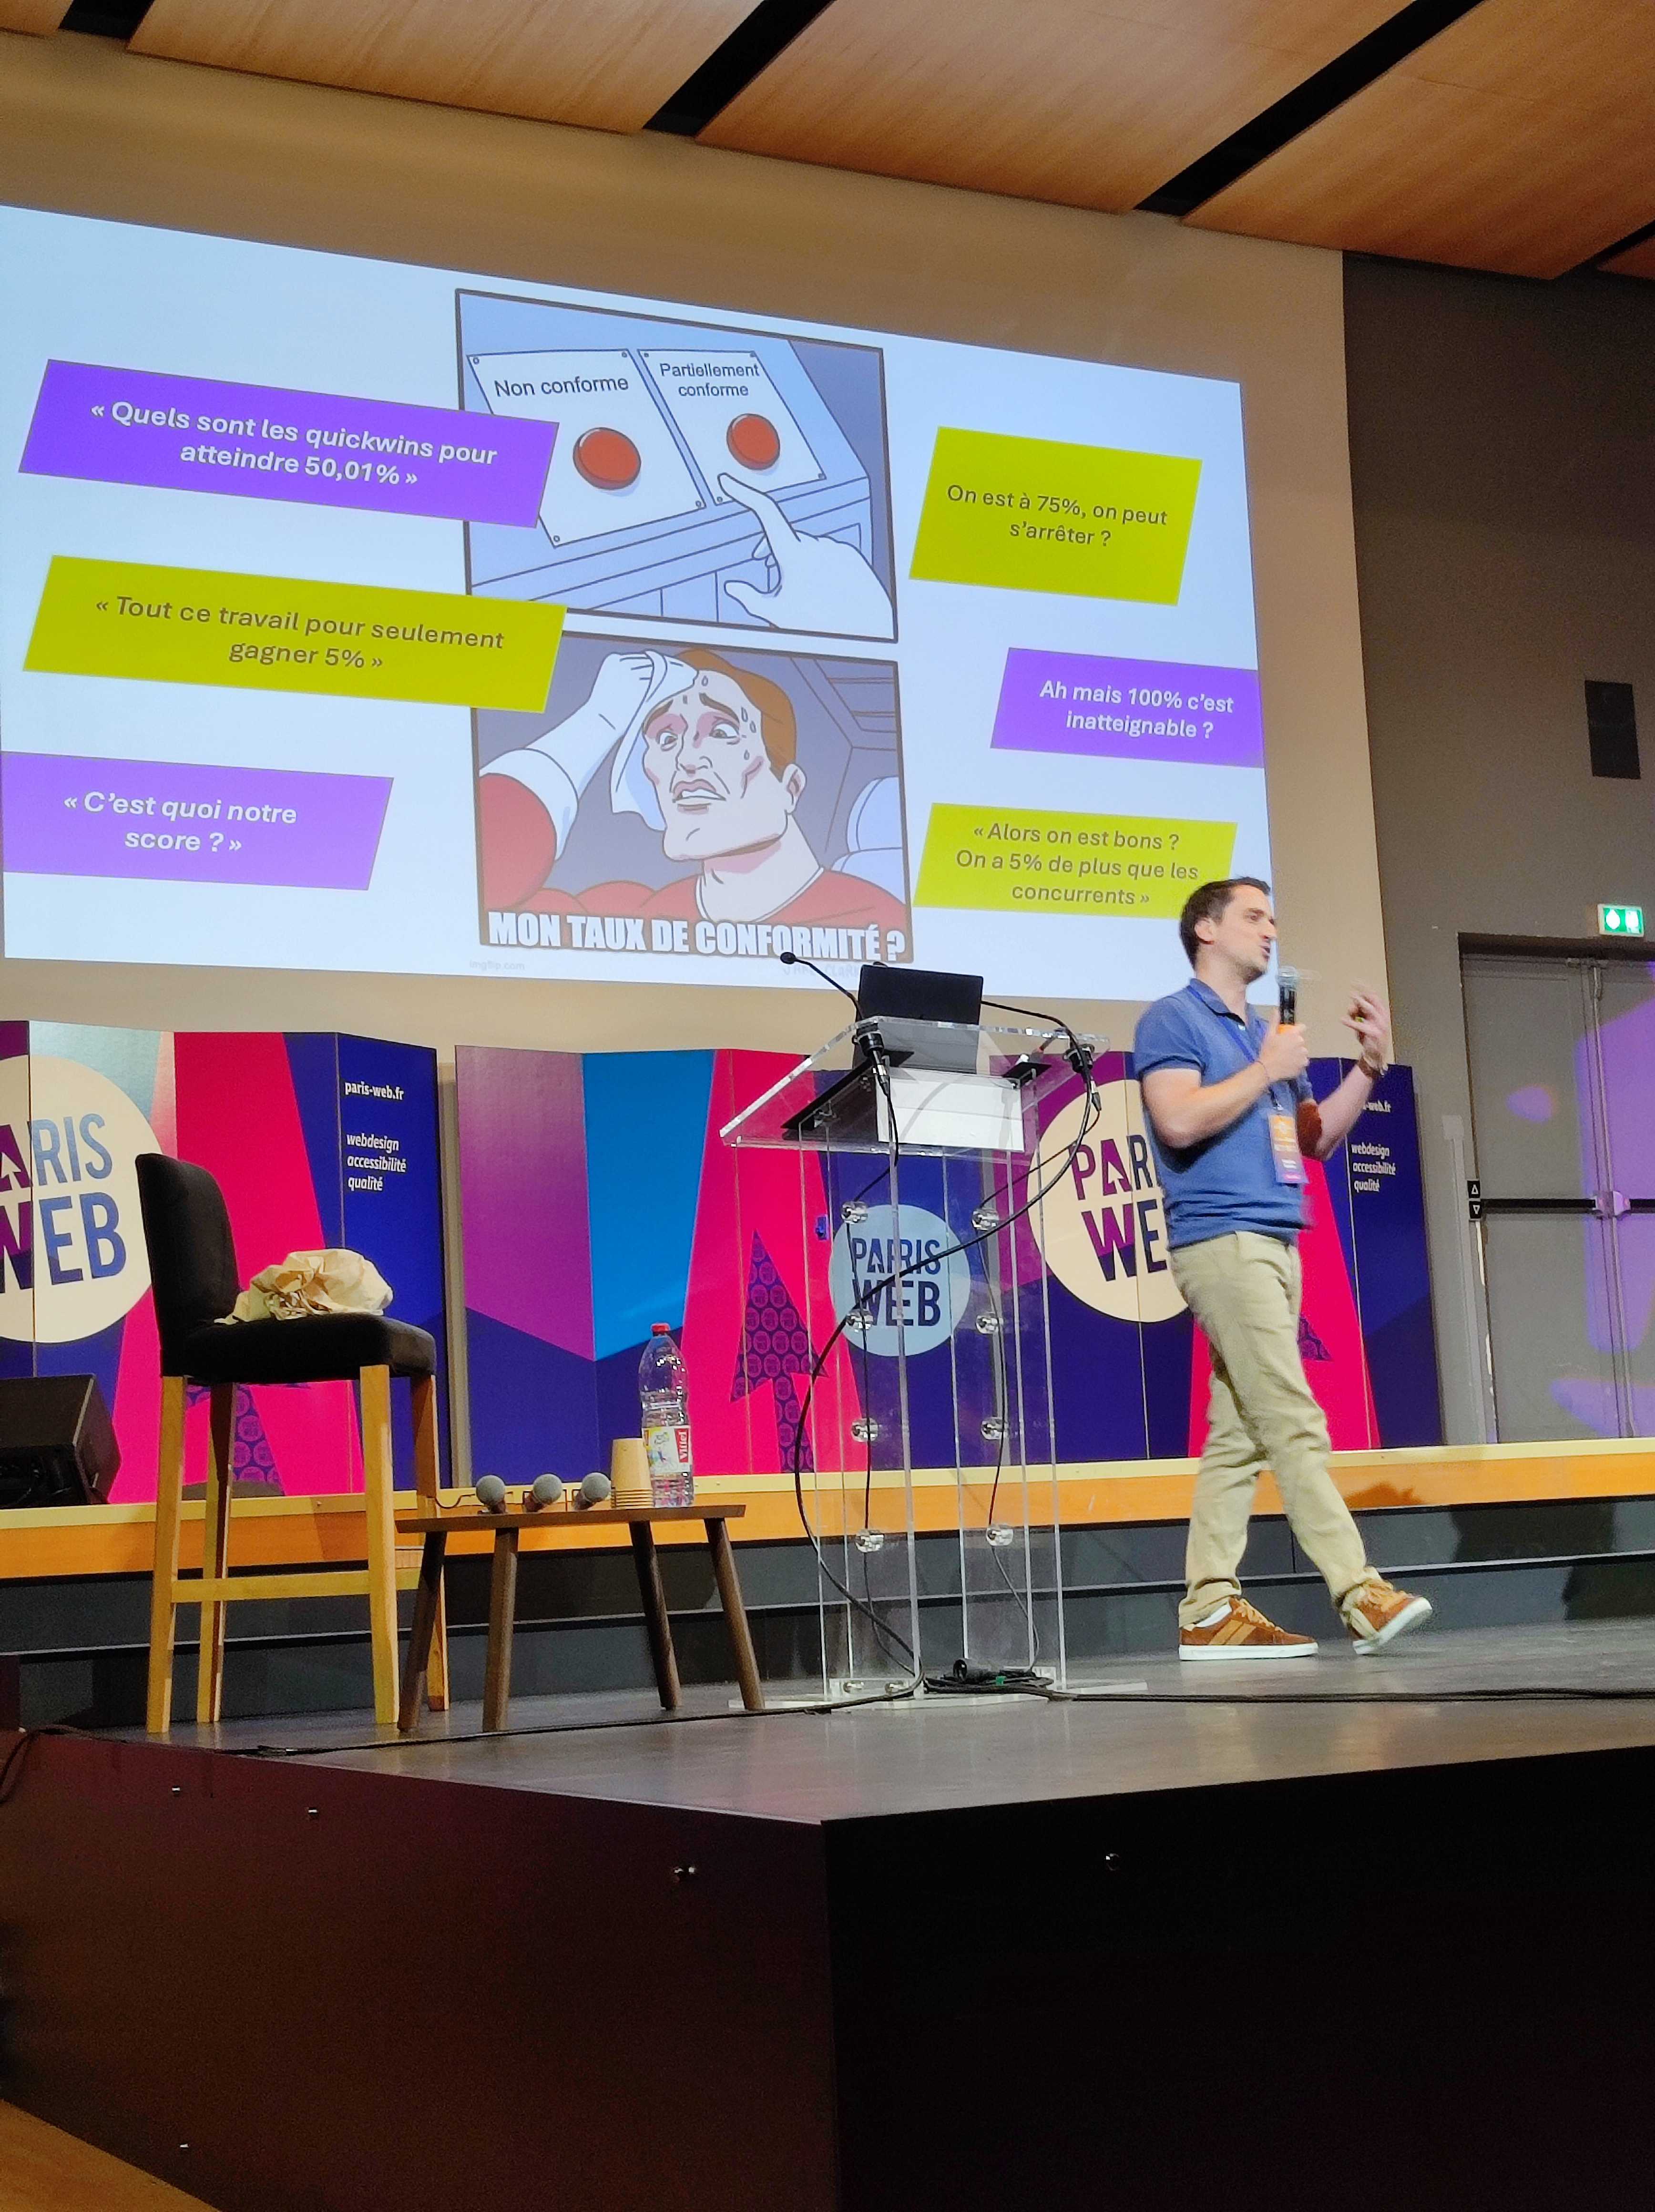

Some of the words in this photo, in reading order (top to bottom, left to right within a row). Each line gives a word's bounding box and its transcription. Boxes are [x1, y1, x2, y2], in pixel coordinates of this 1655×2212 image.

[660, 363, 759, 377] Partiellement
[495, 379, 535, 397] Non
[541, 377, 629, 395] conforme
[678, 383, 748, 397] conforme
[111, 401, 190, 430] Quels
[197, 414, 256, 438] sont
[262, 419, 298, 442] les
[306, 428, 433, 458] quickwins
[439, 443, 497, 466] pour
[180, 443, 299, 474] atteindre
[305, 457, 400, 485] 50,01%
[947, 485, 976, 503] On
[982, 493, 1013, 508] est
[1020, 492, 1030, 509] à
[1037, 496, 1086, 519] 75%,
[1093, 505, 1116, 520] on
[1123, 509, 1167, 525] peut
[1010, 521, 1094, 545] s’arrêter
[1101, 530, 1111, 546] ?
[116, 596, 173, 619] Tout
[179, 604, 211, 623] ce
[219, 607, 298, 631] travail
[305, 618, 365, 645] pour
[371, 623, 504, 649] seulement
[229, 642, 317, 666] gagner
[325, 647, 365, 668] 5%
[1040, 680, 1067, 699] Ah
[1073, 686, 1122, 704] mais
[1128, 688, 1182, 708] 100%
[1188, 695, 1233, 713] c’est
[1066, 711, 1196, 737] inatteignable
[1203, 722, 1213, 739] ?
[84, 791, 155, 816] C’est
[162, 799, 221, 822] quoi
[227, 802, 297, 824] notre
[124, 831, 200, 851] score
[209, 832, 224, 851] ?
[987, 823, 1041, 842] Alors
[1047, 831, 1072, 844] on
[1078, 832, 1109, 846] est
[1114, 831, 1162, 850] bons
[1169, 834, 1179, 850] ?
[957, 850, 986, 868] On
[991, 856, 1002, 869] a
[1010, 854, 1042, 871] 5%
[1049, 855, 1073, 872] de
[1079, 858, 1121, 877] plus
[1127, 864, 1164, 880] que
[1171, 862, 1198, 880] les
[1012, 884, 1135, 904] concurrents
[488, 911, 562, 946] MON
[566, 915, 646, 950] TAUX
[652, 919, 689, 952] DE
[695, 921, 881, 960] CONFORMITÉ
[887, 930, 906, 962] ?
[345, 1081, 404, 1100] paris-web.fr
[347, 1133, 398, 1154] webdesign
[1351, 1142, 1389, 1159] webdesign
[347, 1156, 406, 1172] accessibilité
[1068, 1135, 1157, 1200] PAR
[1353, 1161, 1396, 1176] accessibilité
[348, 1176, 383, 1191] qualité
[1354, 1178, 1380, 1193] qualité
[852, 1238, 940, 1275] PARIS
[852, 1280, 940, 1326] WEB
